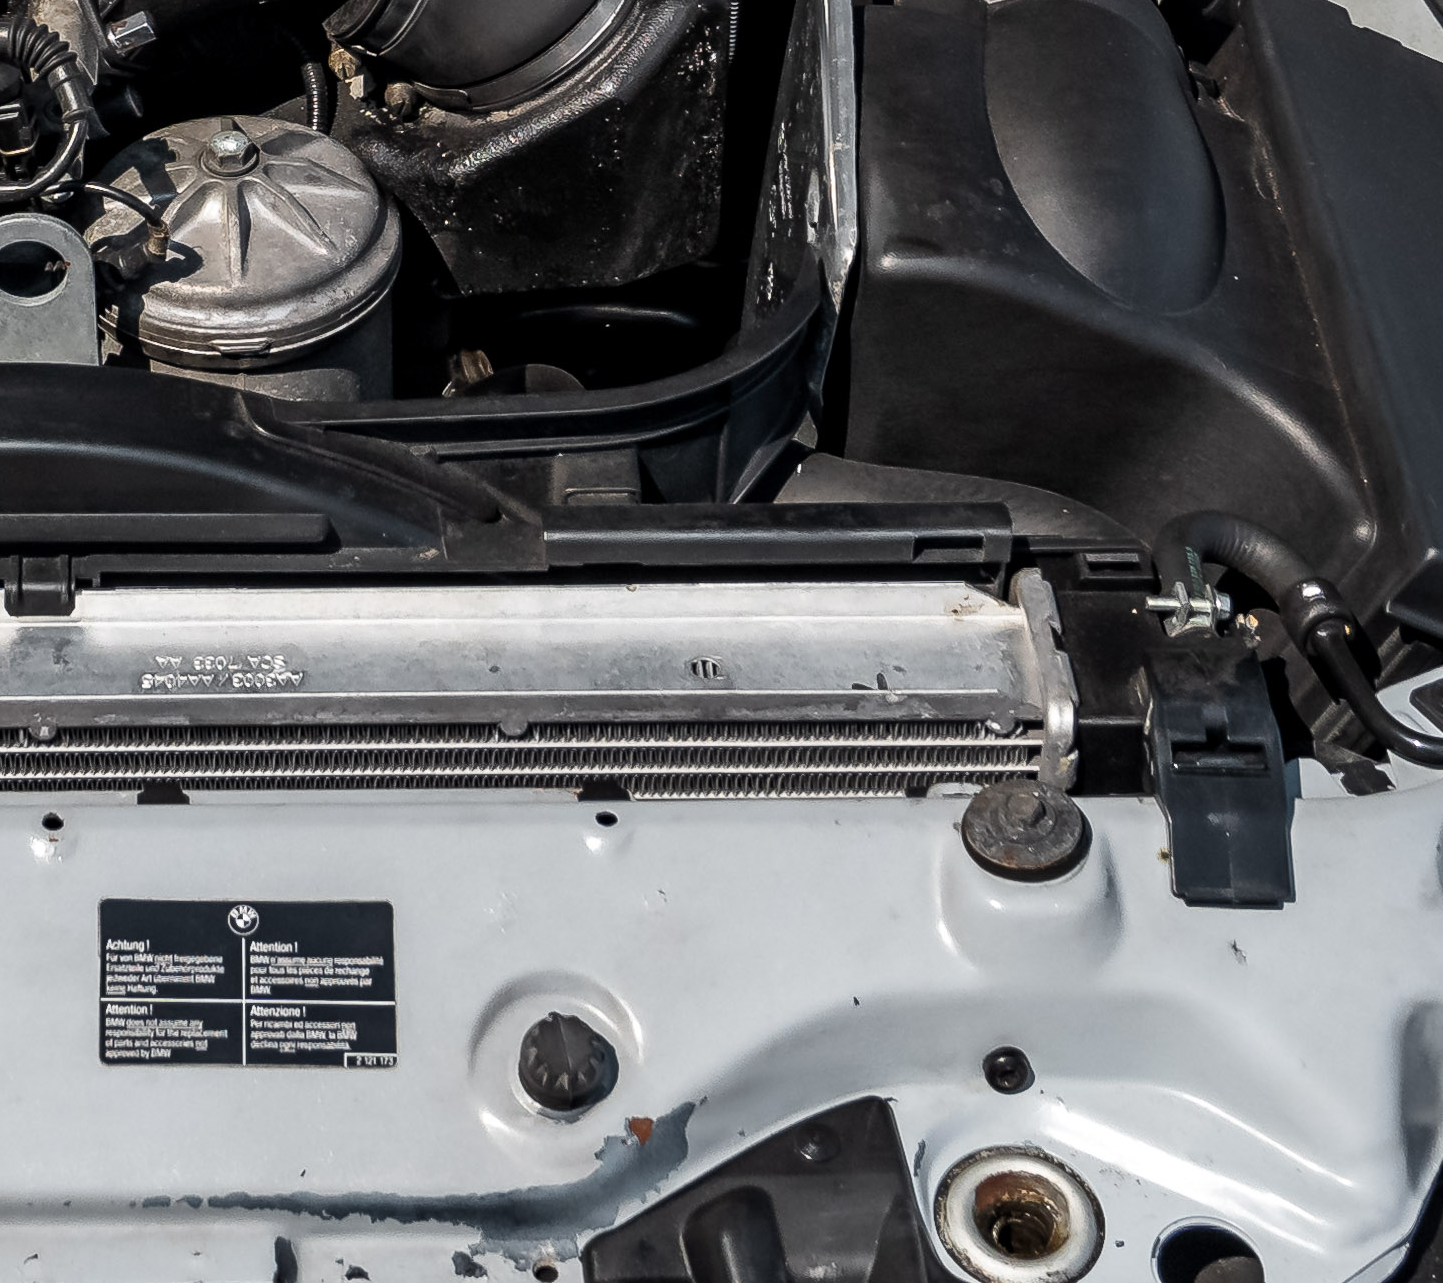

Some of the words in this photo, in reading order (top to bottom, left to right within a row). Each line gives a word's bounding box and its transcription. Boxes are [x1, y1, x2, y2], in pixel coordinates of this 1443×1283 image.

[106, 939, 145, 952] Achtung
[250, 941, 293, 953] Attention
[134, 953, 153, 962] BMW
[250, 954, 269, 964] BMW
[105, 1004, 147, 1015] Attention
[250, 1005, 301, 1017] Attenzione
[105, 1017, 125, 1027] BMW
[151, 1048, 171, 1058] BMW
